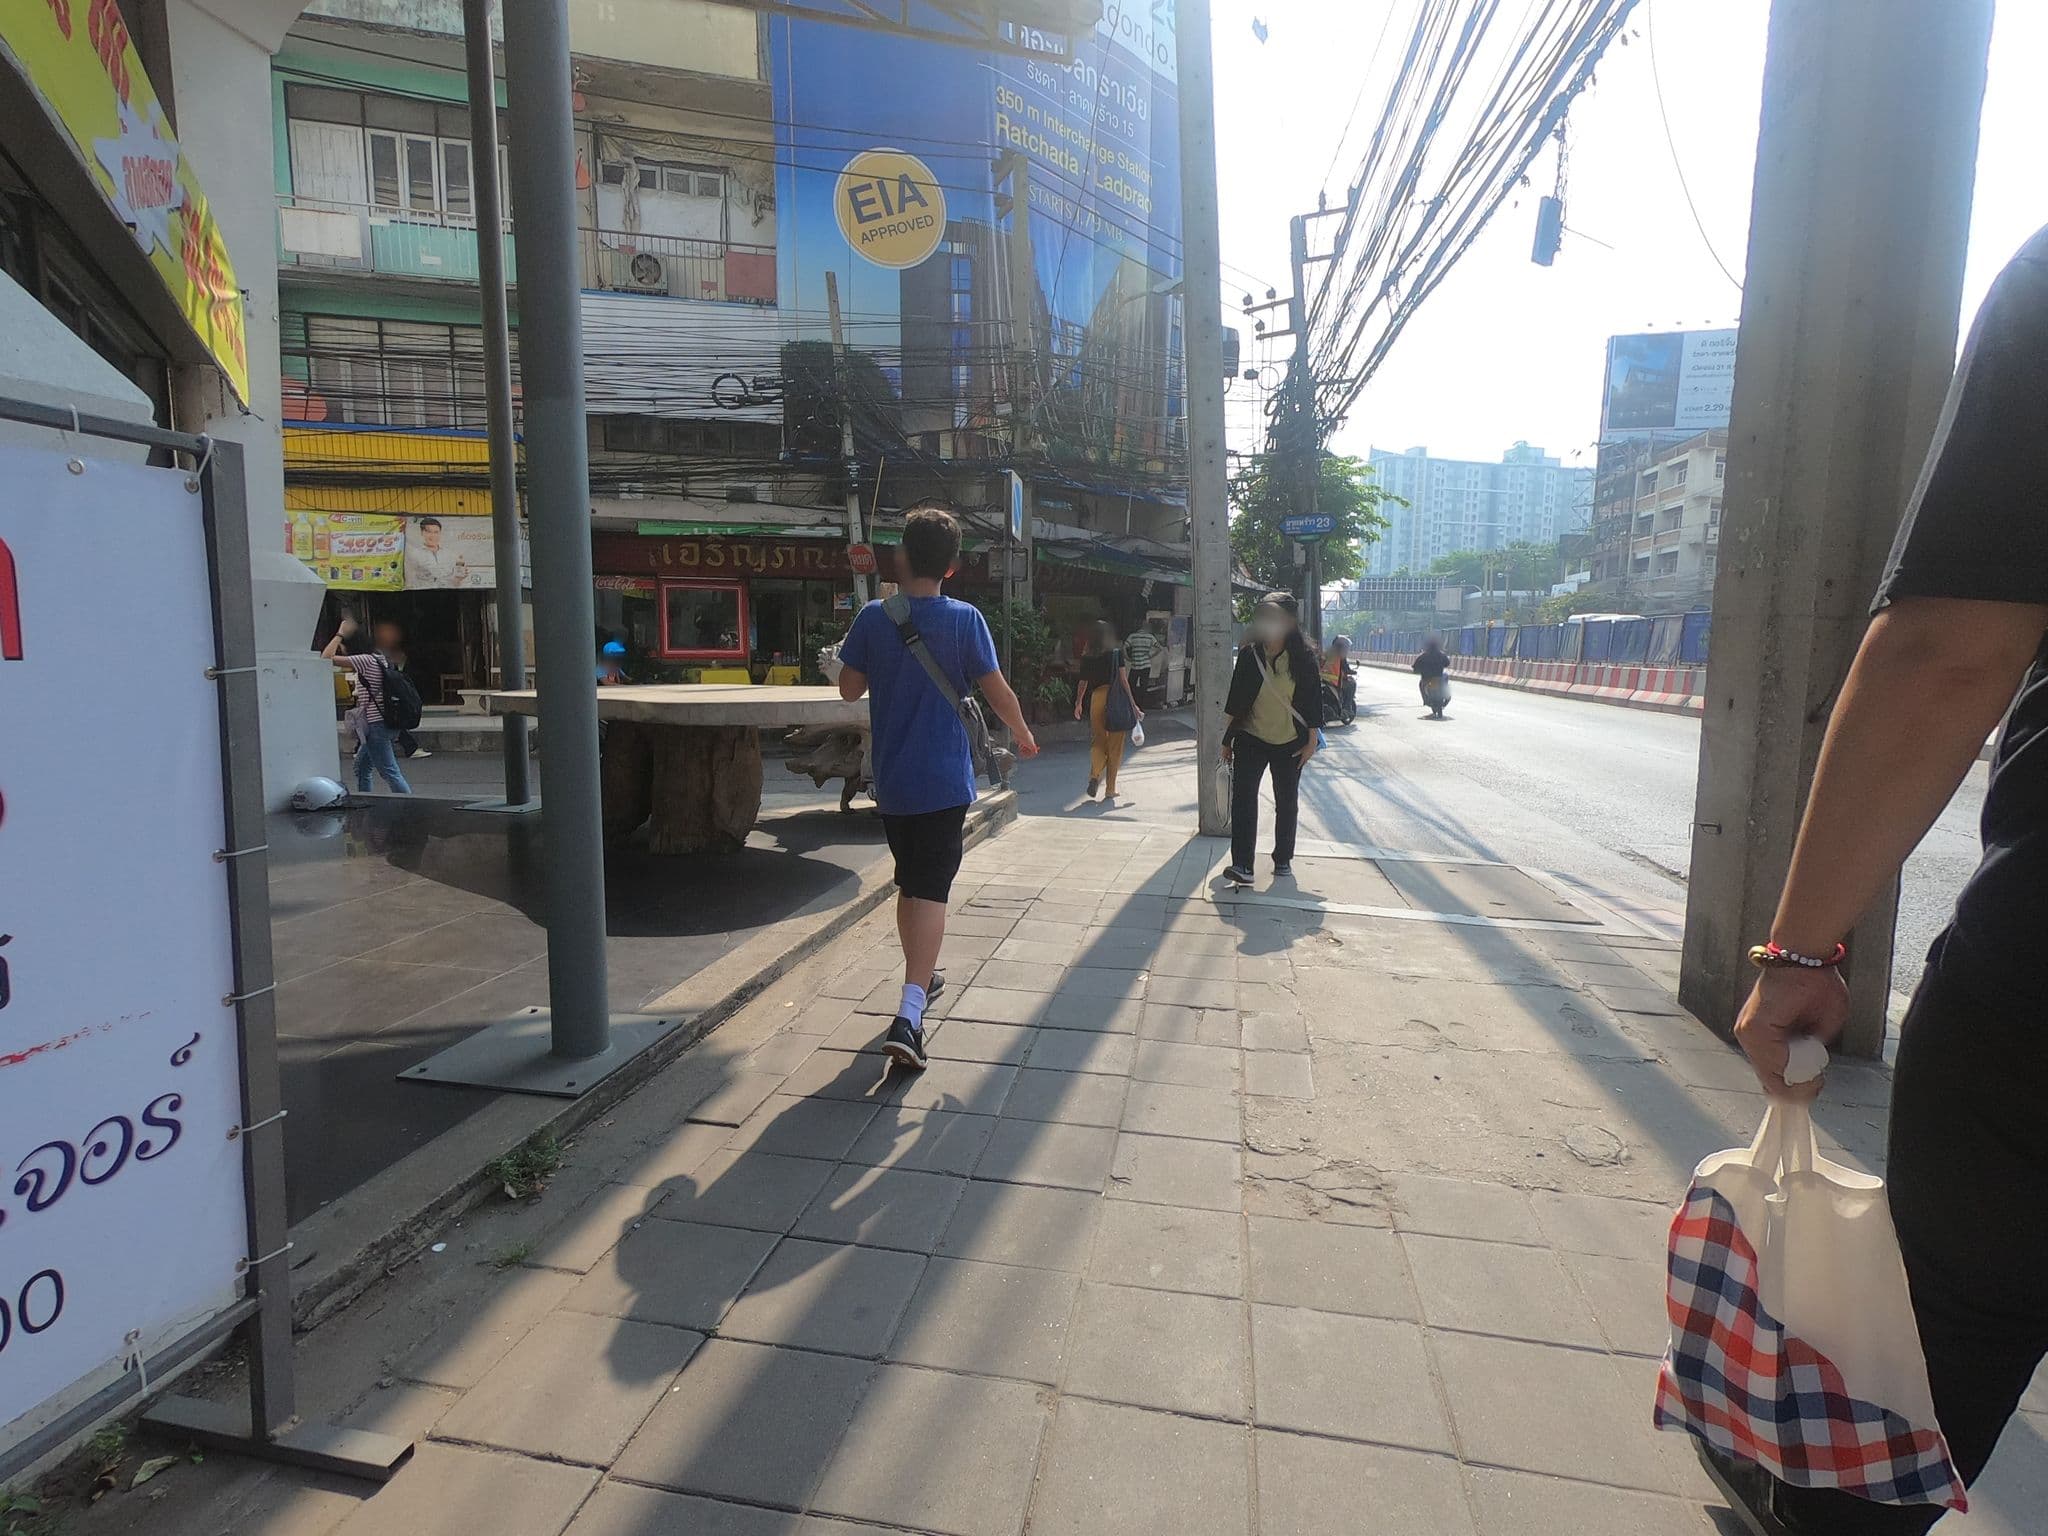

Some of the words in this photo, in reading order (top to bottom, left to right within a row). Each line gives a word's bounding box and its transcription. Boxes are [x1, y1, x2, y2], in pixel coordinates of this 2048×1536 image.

[1026, 59, 1057, 93] รัชดา
[1069, 90, 1119, 129] ลาดพร้าว
[1122, 120, 1135, 138] 15
[996, 86, 1024, 115] 350
[1027, 104, 1040, 122] m
[1043, 110, 1115, 165] Interchange
[1117, 152, 1153, 189] Station
[996, 112, 1080, 176] Ratchada
[1095, 165, 1153, 214] Ladprao
[847, 173, 929, 224] EIA
[861, 214, 935, 245] APPROVED
[1316, 516, 1330, 529] 23
